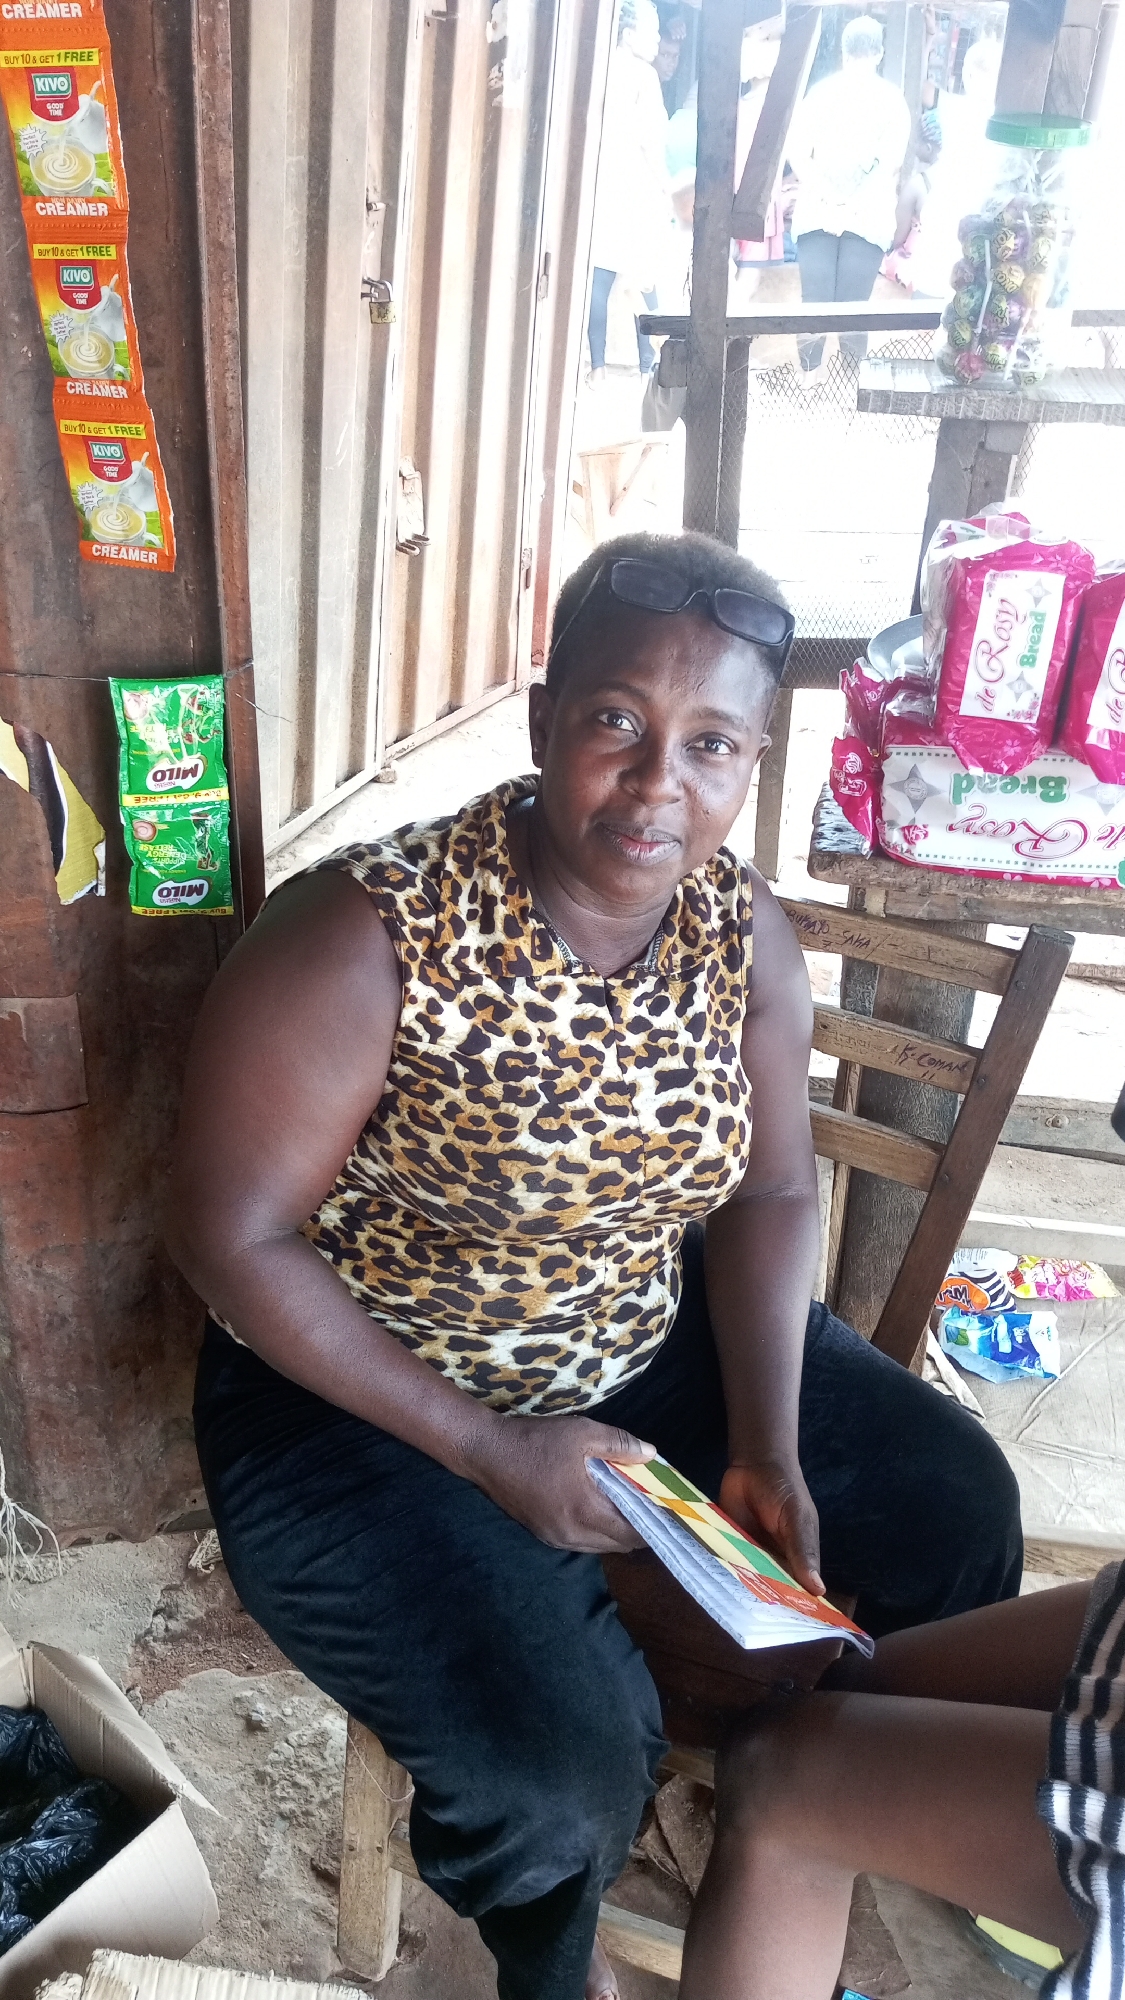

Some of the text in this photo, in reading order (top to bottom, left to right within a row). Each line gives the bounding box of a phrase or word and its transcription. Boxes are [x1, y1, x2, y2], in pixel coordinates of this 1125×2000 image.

[1, 2, 83, 19] CREAMER
[4, 55, 20, 65] BUY
[20, 53, 31, 65] 10
[39, 55, 54, 64] GET
[56, 52, 61, 63] 1
[63, 51, 94, 62] FREE
[35, 77, 69, 91] KIVO
[46, 102, 64, 110] GOOD
[35, 202, 109, 216] CREAMER
[38, 248, 50, 257] BUY
[51, 246, 59, 256] 10
[65, 249, 79, 257] GET
[79, 246, 84, 256] 1
[86, 246, 112, 257] FREE
[63, 269, 91, 282] KIVO
[66, 381, 129, 399] CREAMER
[64, 424, 78, 432] BUY
[78, 423, 86, 433] 10
[93, 427, 106, 435] GET
[107, 425, 113, 435] 1
[114, 426, 142, 436] FREE
[92, 444, 120, 458] KIVO
[92, 544, 158, 565] CREAMER
[1018, 609, 1047, 669] Bread
[975, 598, 1028, 712] de Rosy
[152, 763, 199, 783] MILO
[951, 772, 1068, 806] Bread
[947, 804, 1089, 860] Rosy
[158, 883, 205, 898] MILO
[917, 1052, 968, 1073] COMAN
